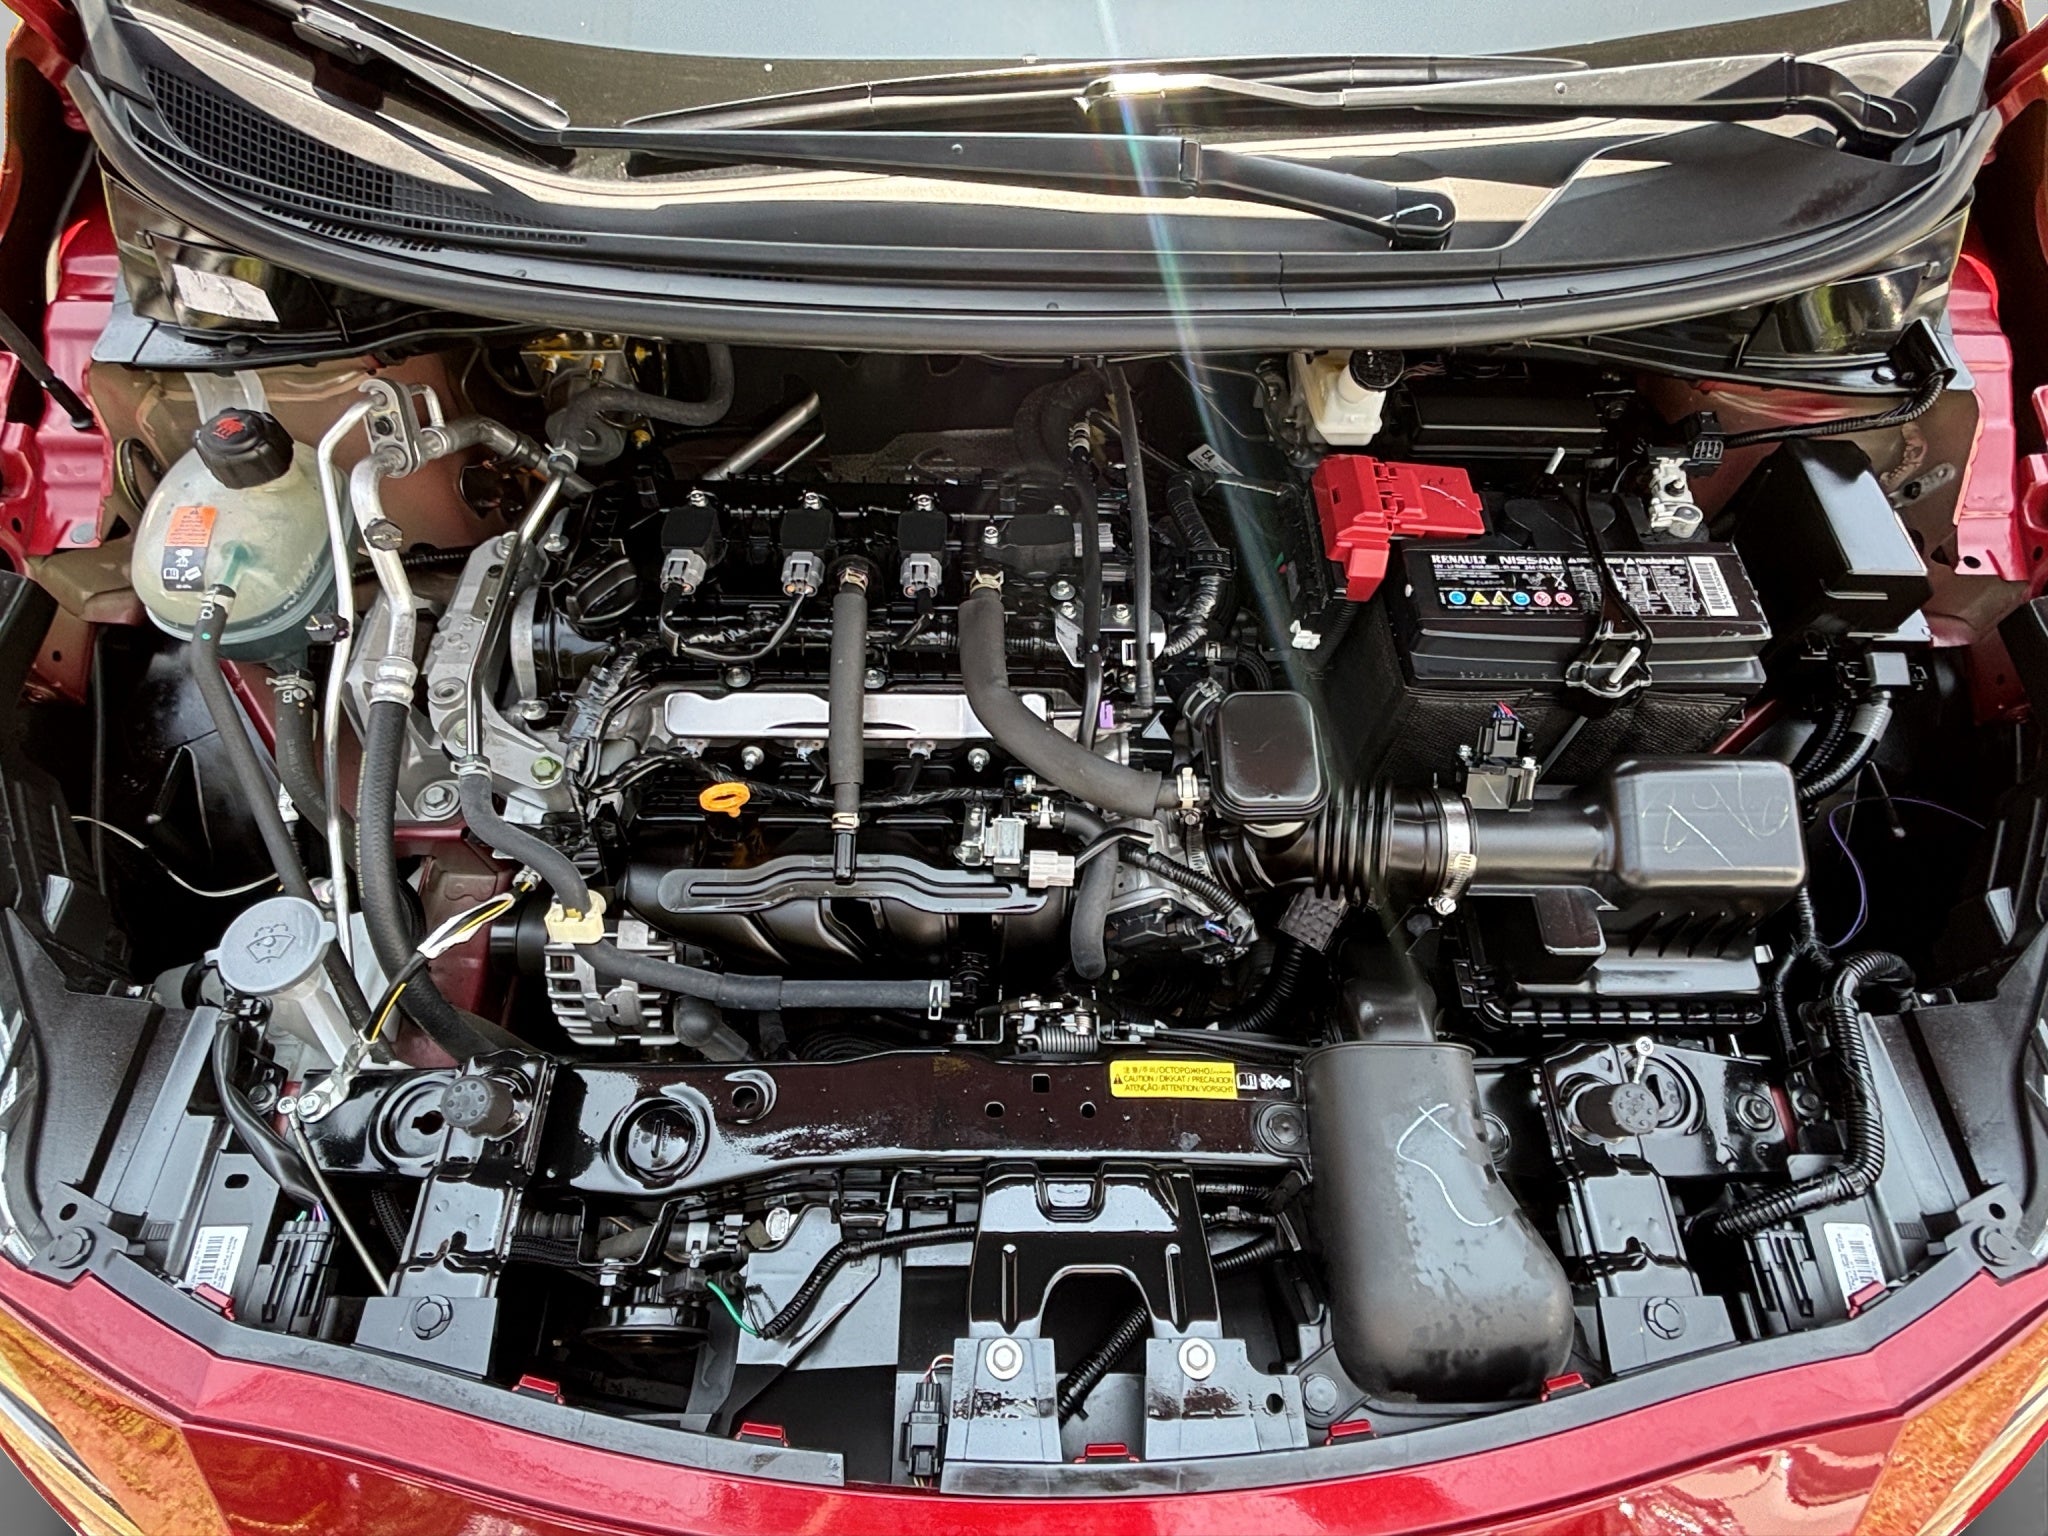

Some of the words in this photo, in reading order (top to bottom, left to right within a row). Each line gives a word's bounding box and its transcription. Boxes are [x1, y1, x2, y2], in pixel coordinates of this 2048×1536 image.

[1431, 555, 1487, 564] RENAULT
[1499, 556, 1562, 565] NISSAN
[1123, 1075, 1154, 1083] CAUTION
